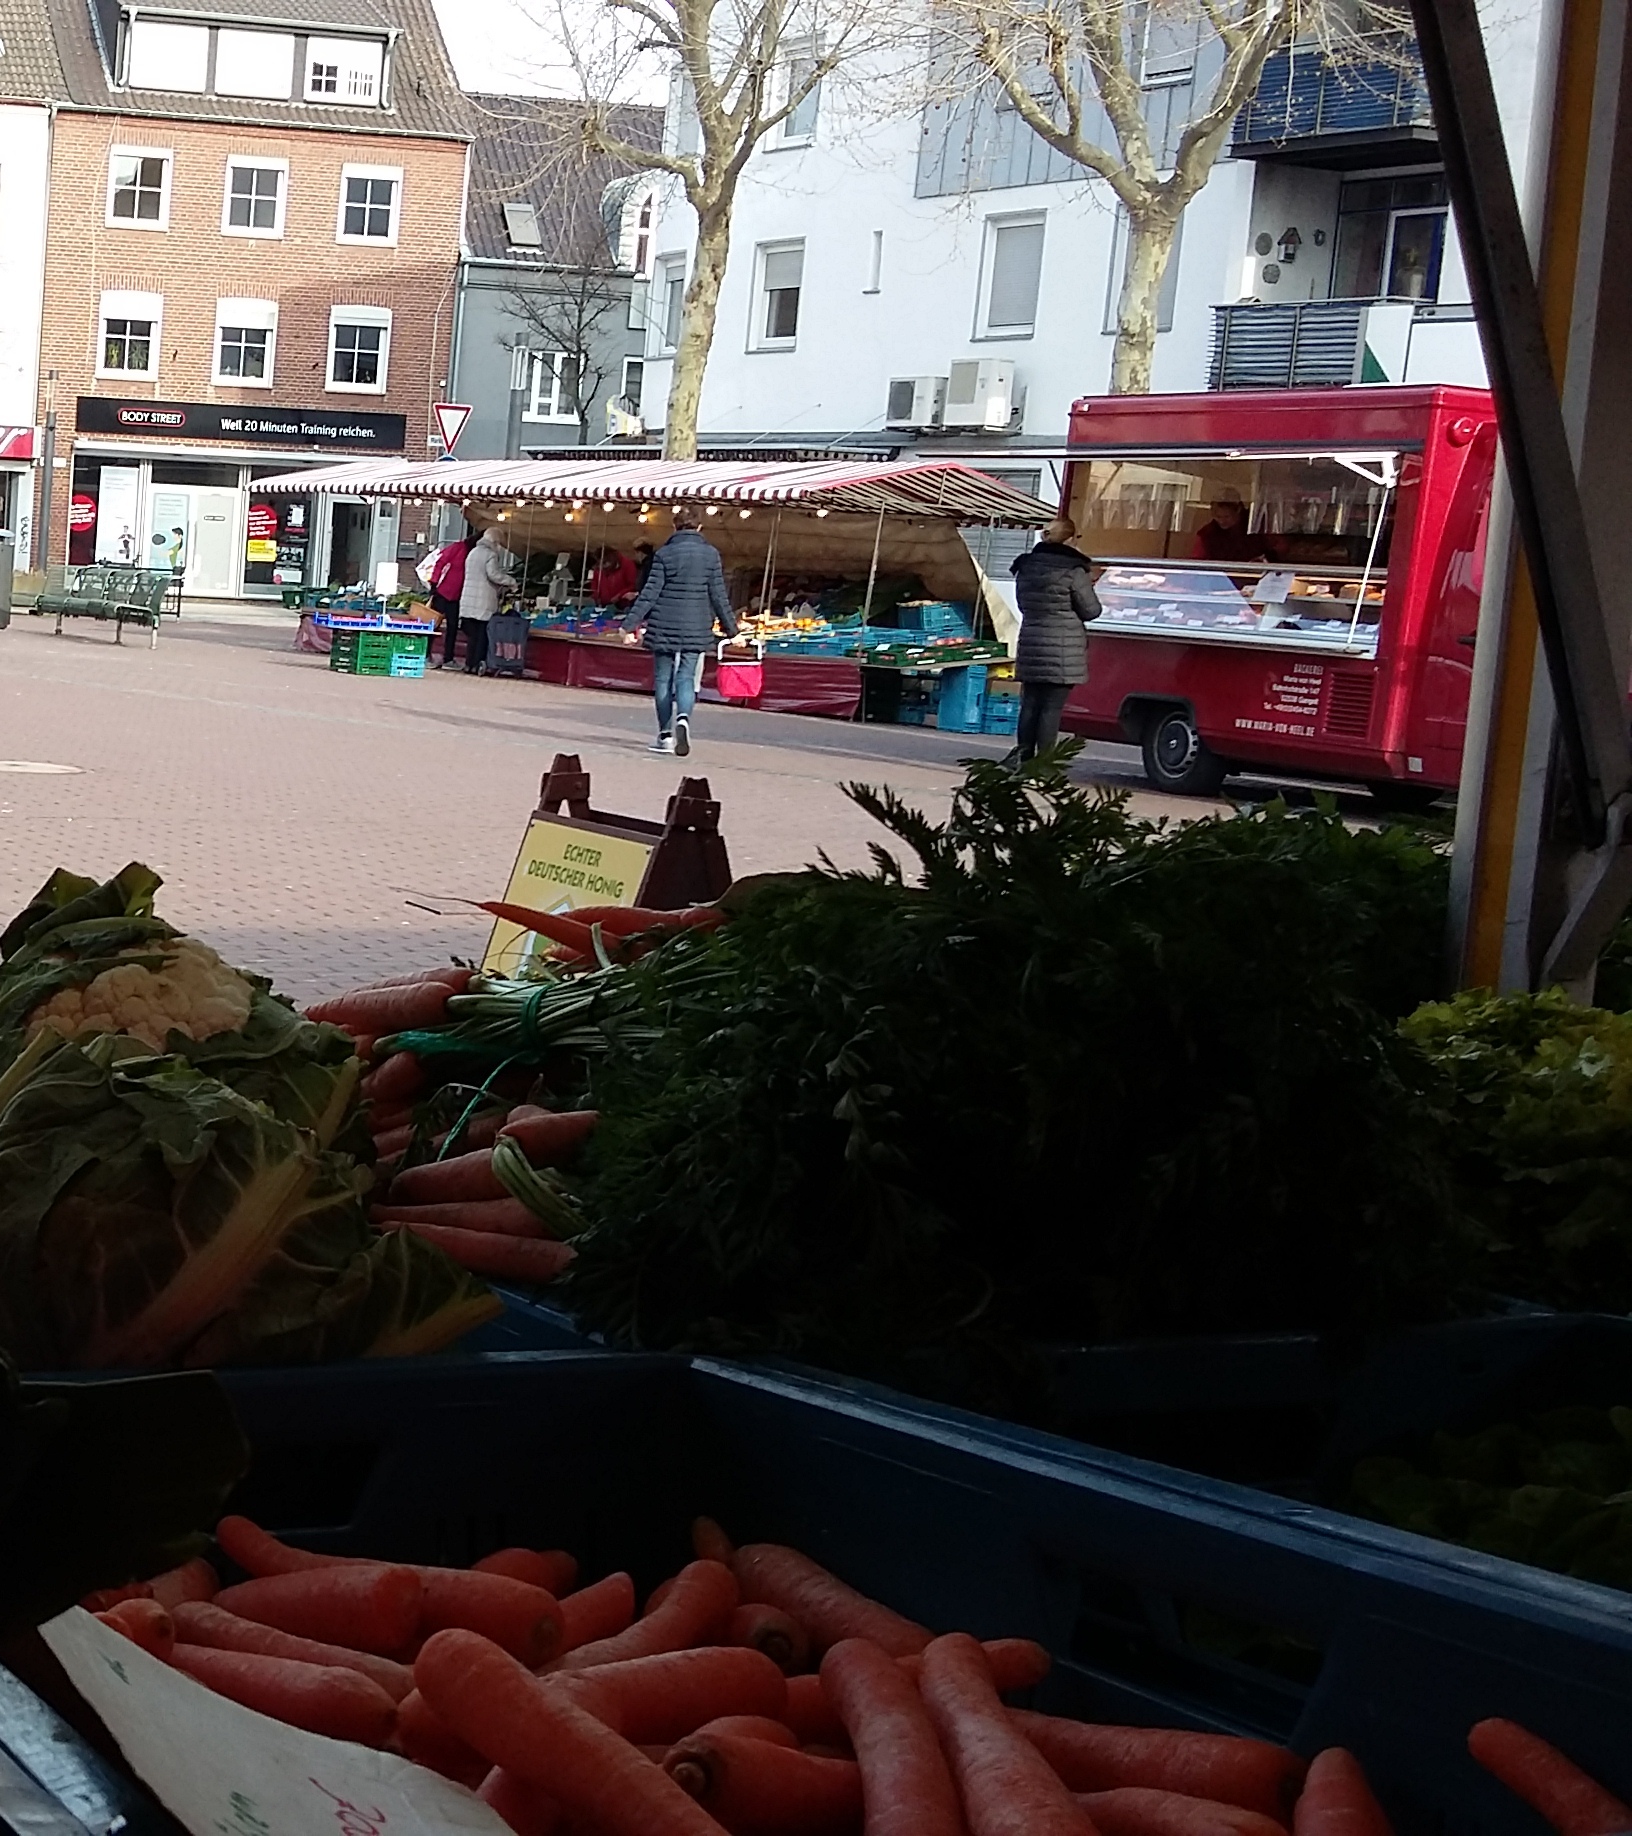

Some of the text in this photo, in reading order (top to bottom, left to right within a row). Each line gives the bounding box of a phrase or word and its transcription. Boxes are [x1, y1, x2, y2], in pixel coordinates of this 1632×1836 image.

[121, 411, 182, 424] BODY STREET
[220, 419, 376, 438] Weil 20 Minuten Training reichen.
[563, 844, 602, 867] ECHTER
[528, 859, 624, 898] DEUTSCHER HONIG
